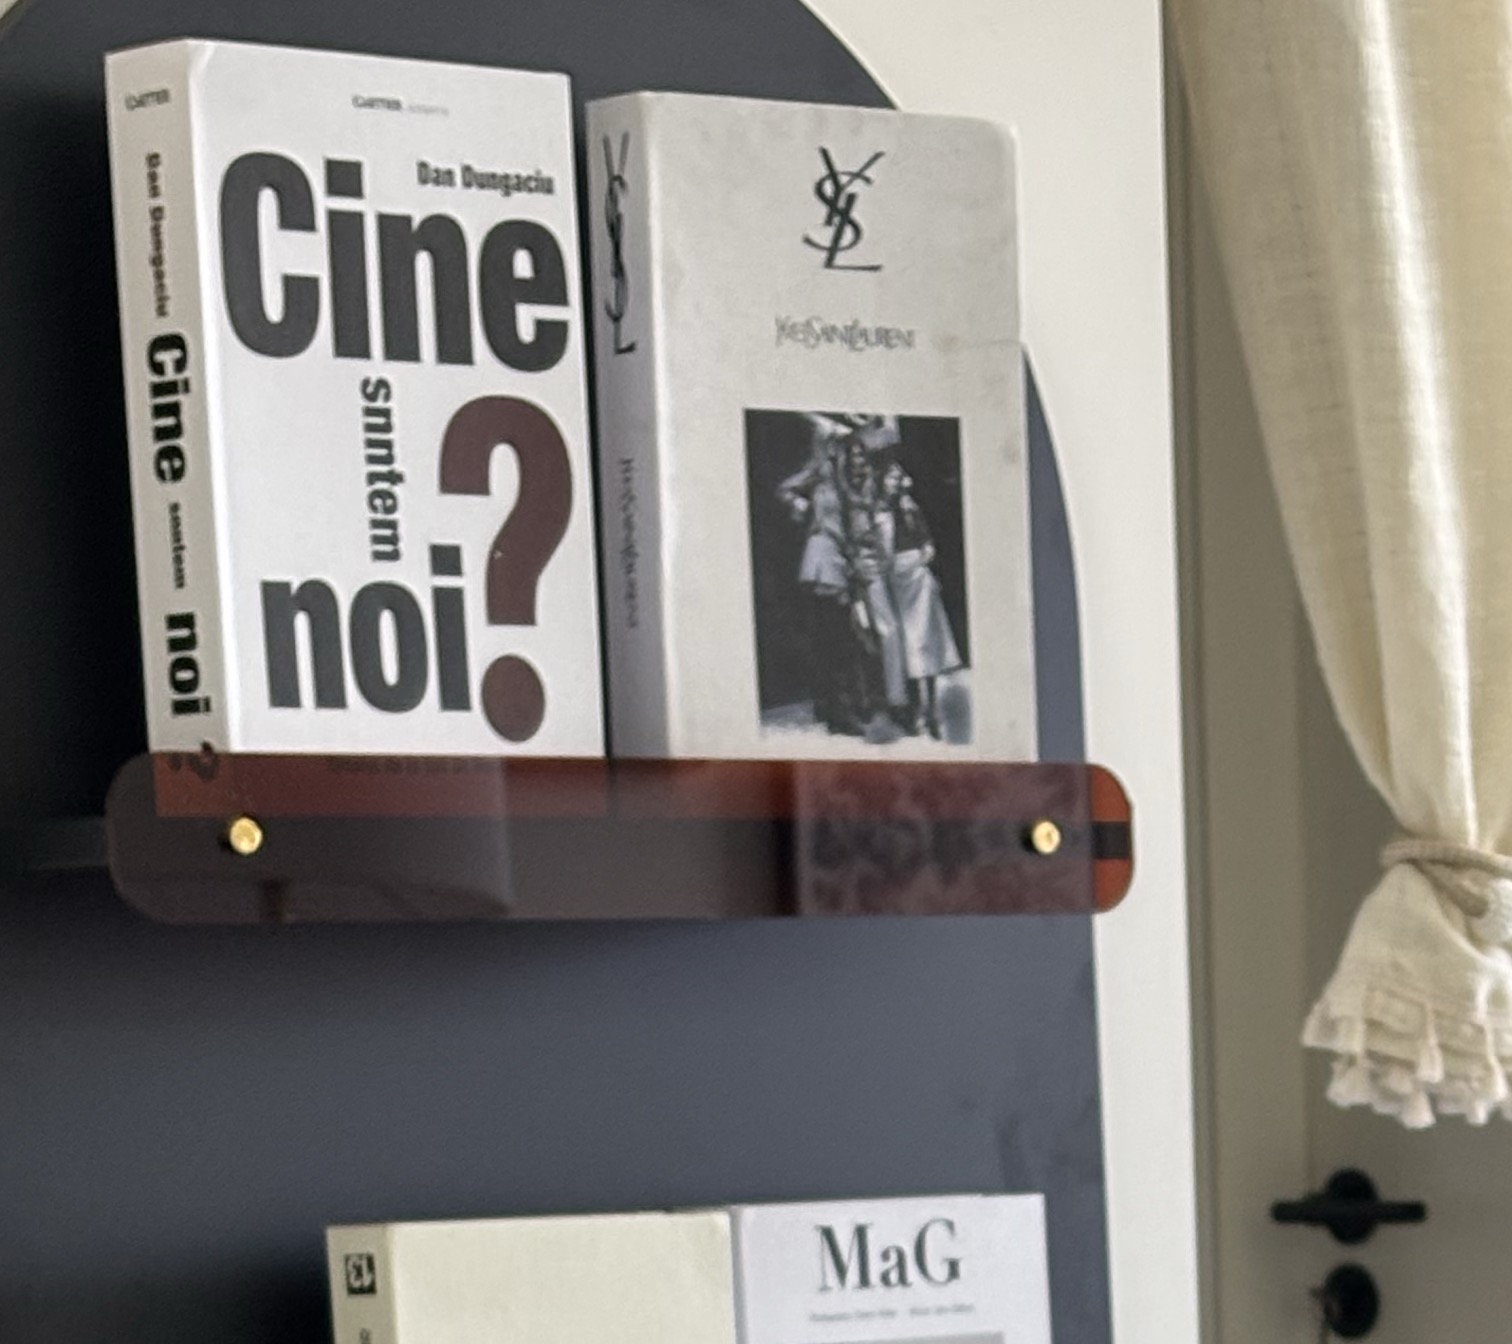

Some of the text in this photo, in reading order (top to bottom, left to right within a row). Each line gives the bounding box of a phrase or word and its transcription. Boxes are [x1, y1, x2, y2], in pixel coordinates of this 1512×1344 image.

[416, 160, 554, 198] Dan Dungaciu
[220, 151, 571, 373] Cine
[147, 333, 191, 485] Cine
[813, 1217, 962, 1293] MaG
